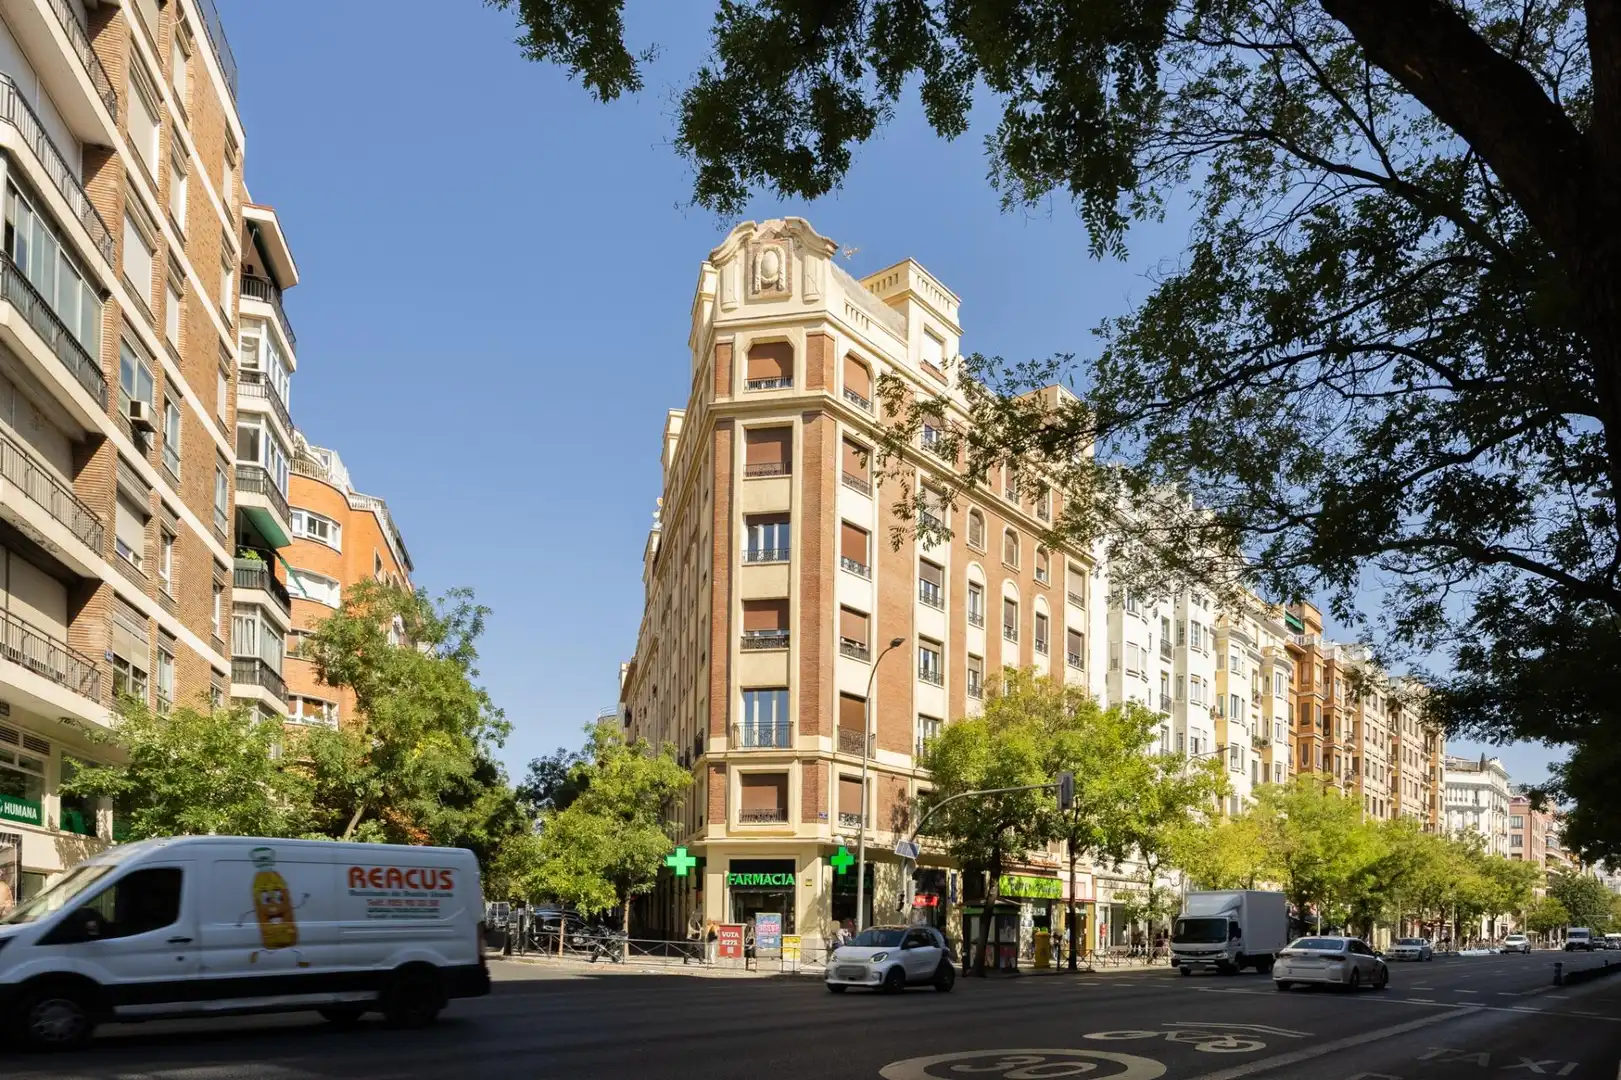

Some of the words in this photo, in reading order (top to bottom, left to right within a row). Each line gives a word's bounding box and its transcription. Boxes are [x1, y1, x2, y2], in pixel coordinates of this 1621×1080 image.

[4, 802, 37, 819] HUMANA
[348, 866, 454, 890] REACUS
[728, 873, 795, 885] FARMACIA
[950, 1055, 1098, 1079] 30
[1417, 1047, 1580, 1076] TAXI
